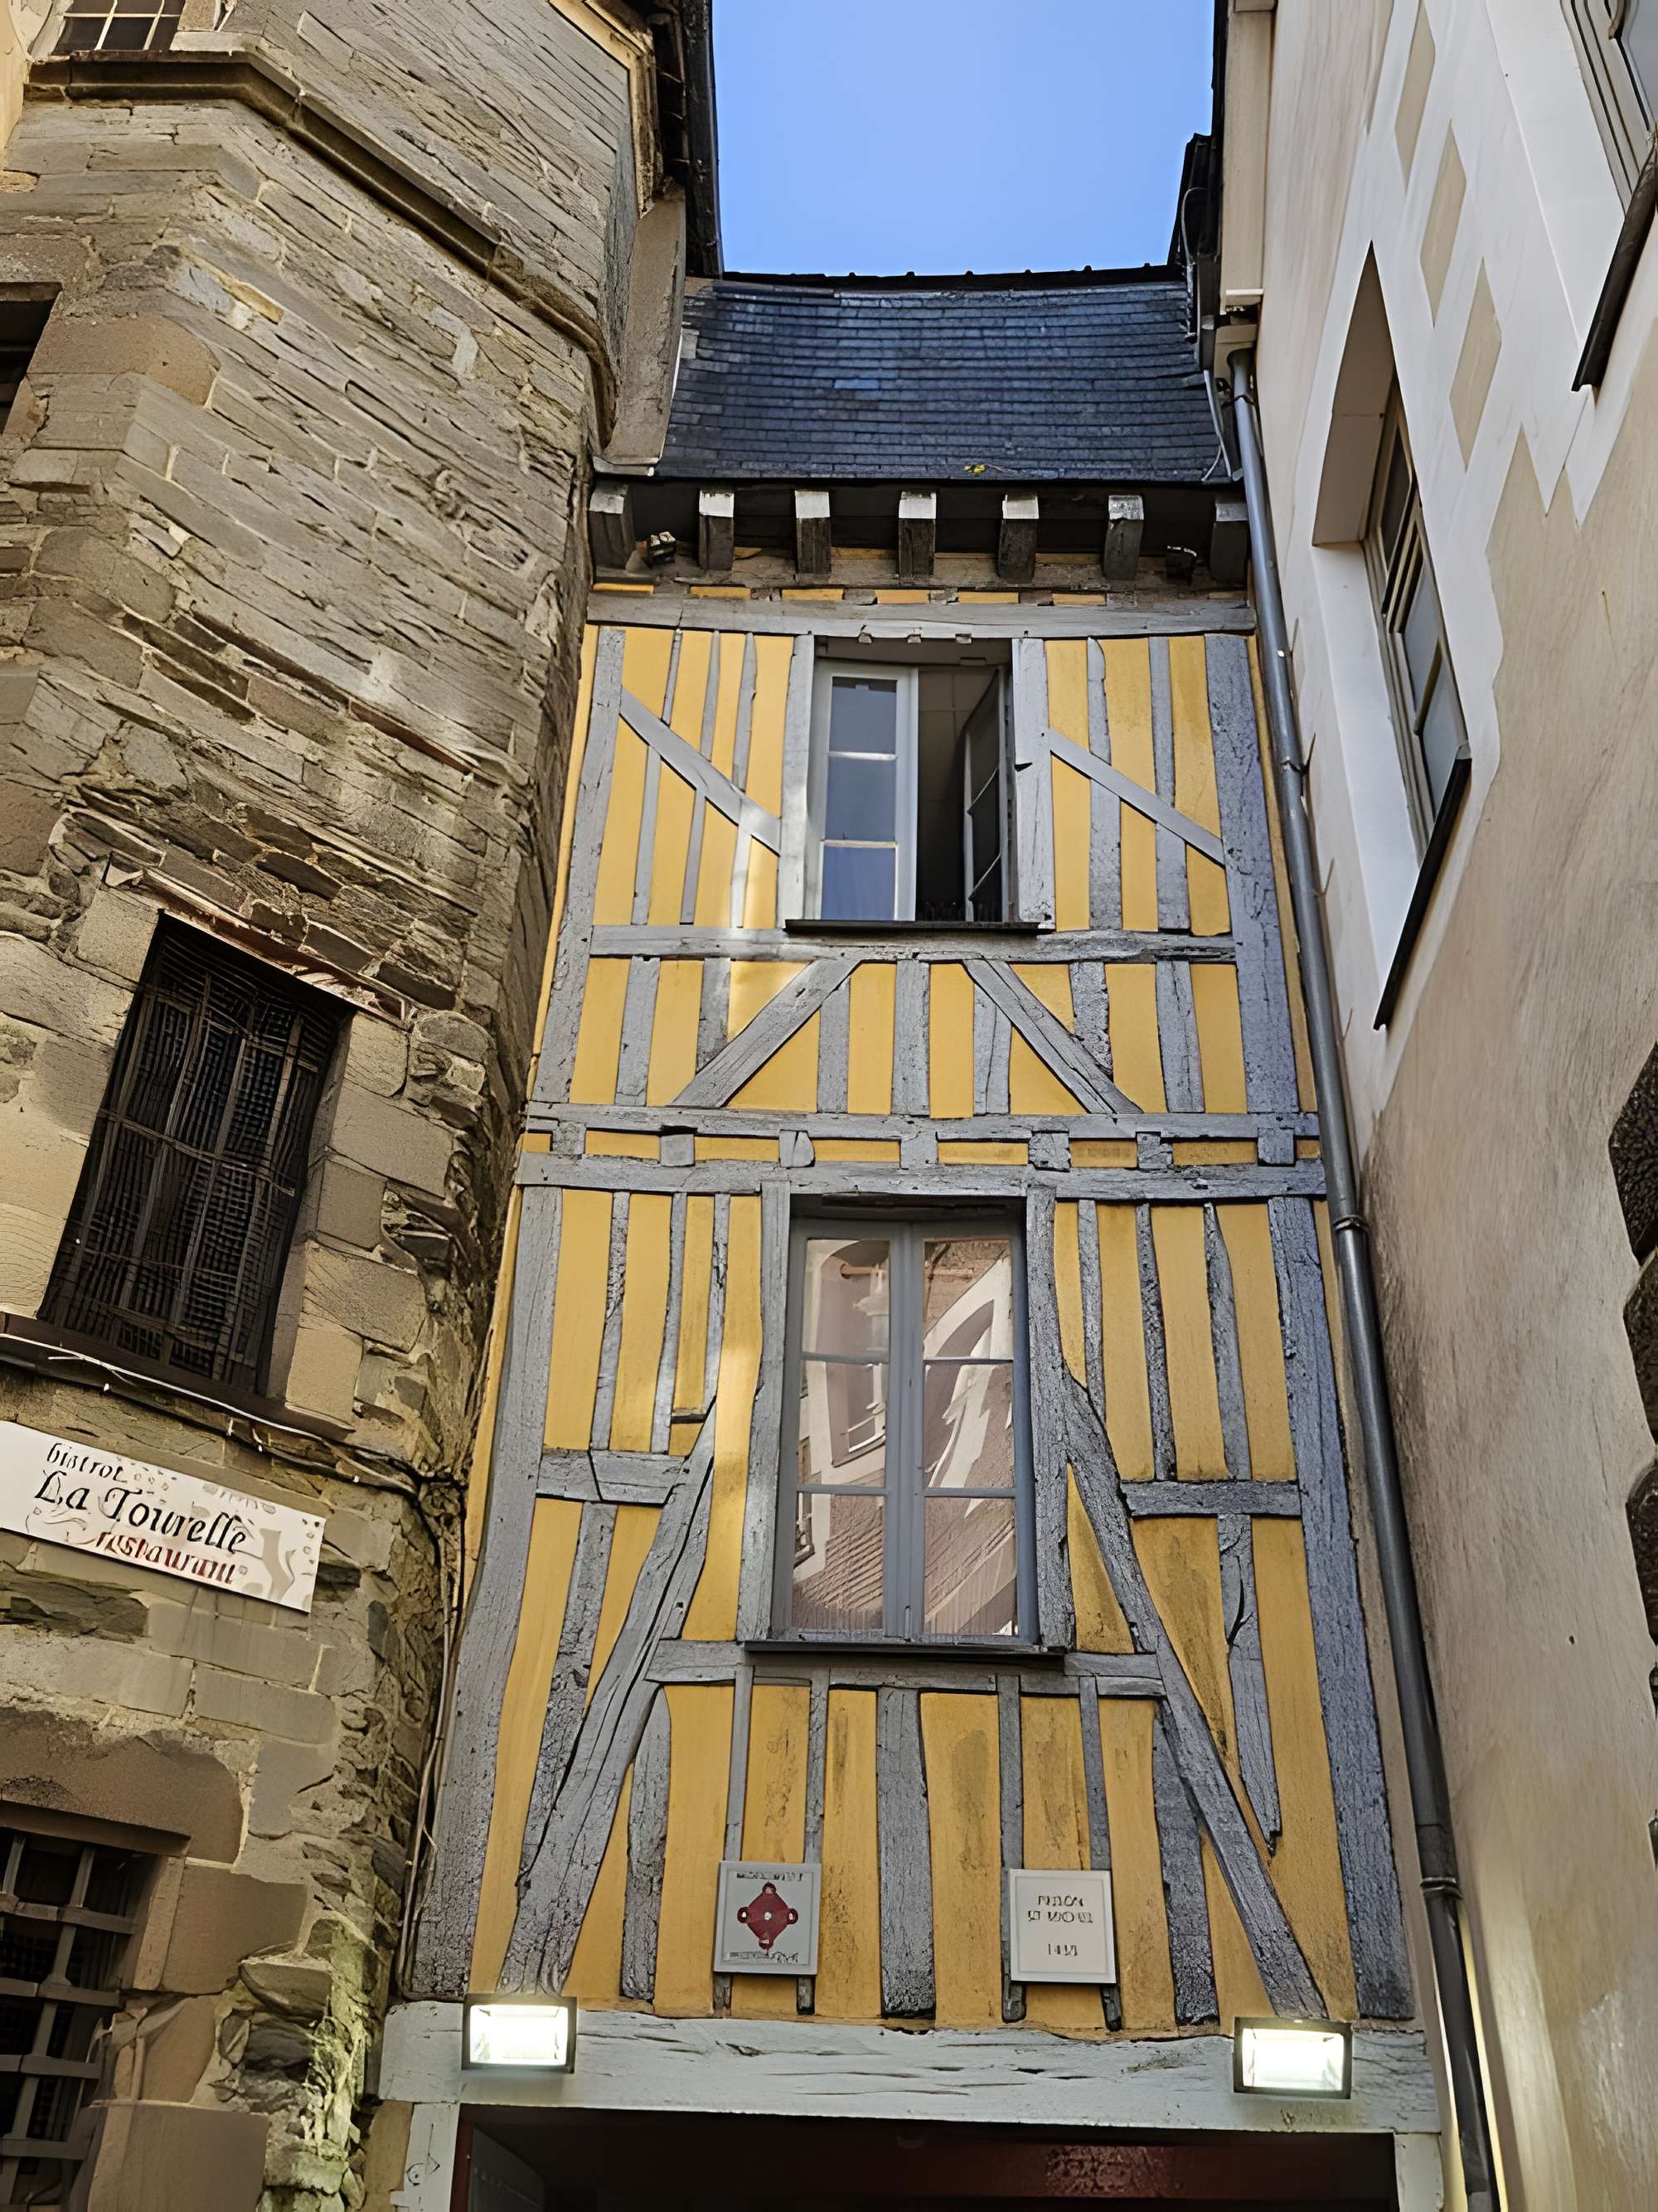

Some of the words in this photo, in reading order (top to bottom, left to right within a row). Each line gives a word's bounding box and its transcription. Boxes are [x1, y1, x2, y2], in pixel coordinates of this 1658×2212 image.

[46, 1443, 128, 1483] bistrot
[35, 1470, 90, 1511] La
[99, 1487, 247, 1554] Tourelle
